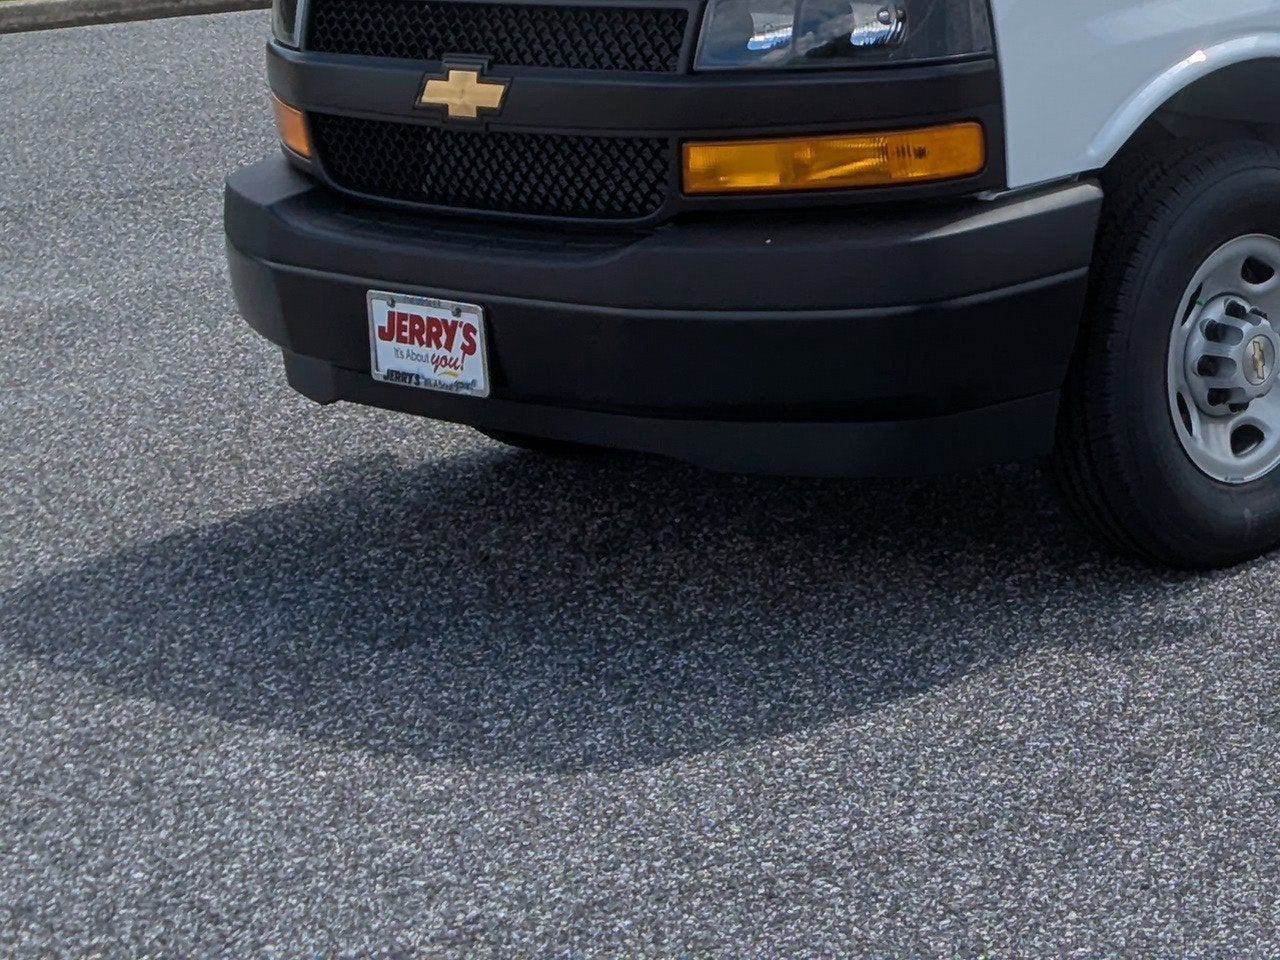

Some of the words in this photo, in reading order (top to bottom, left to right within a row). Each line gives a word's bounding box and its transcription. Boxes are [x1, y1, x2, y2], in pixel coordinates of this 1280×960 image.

[378, 310, 478, 356] JERRY'S
[406, 348, 429, 363] About
[431, 352, 466, 373] you!
